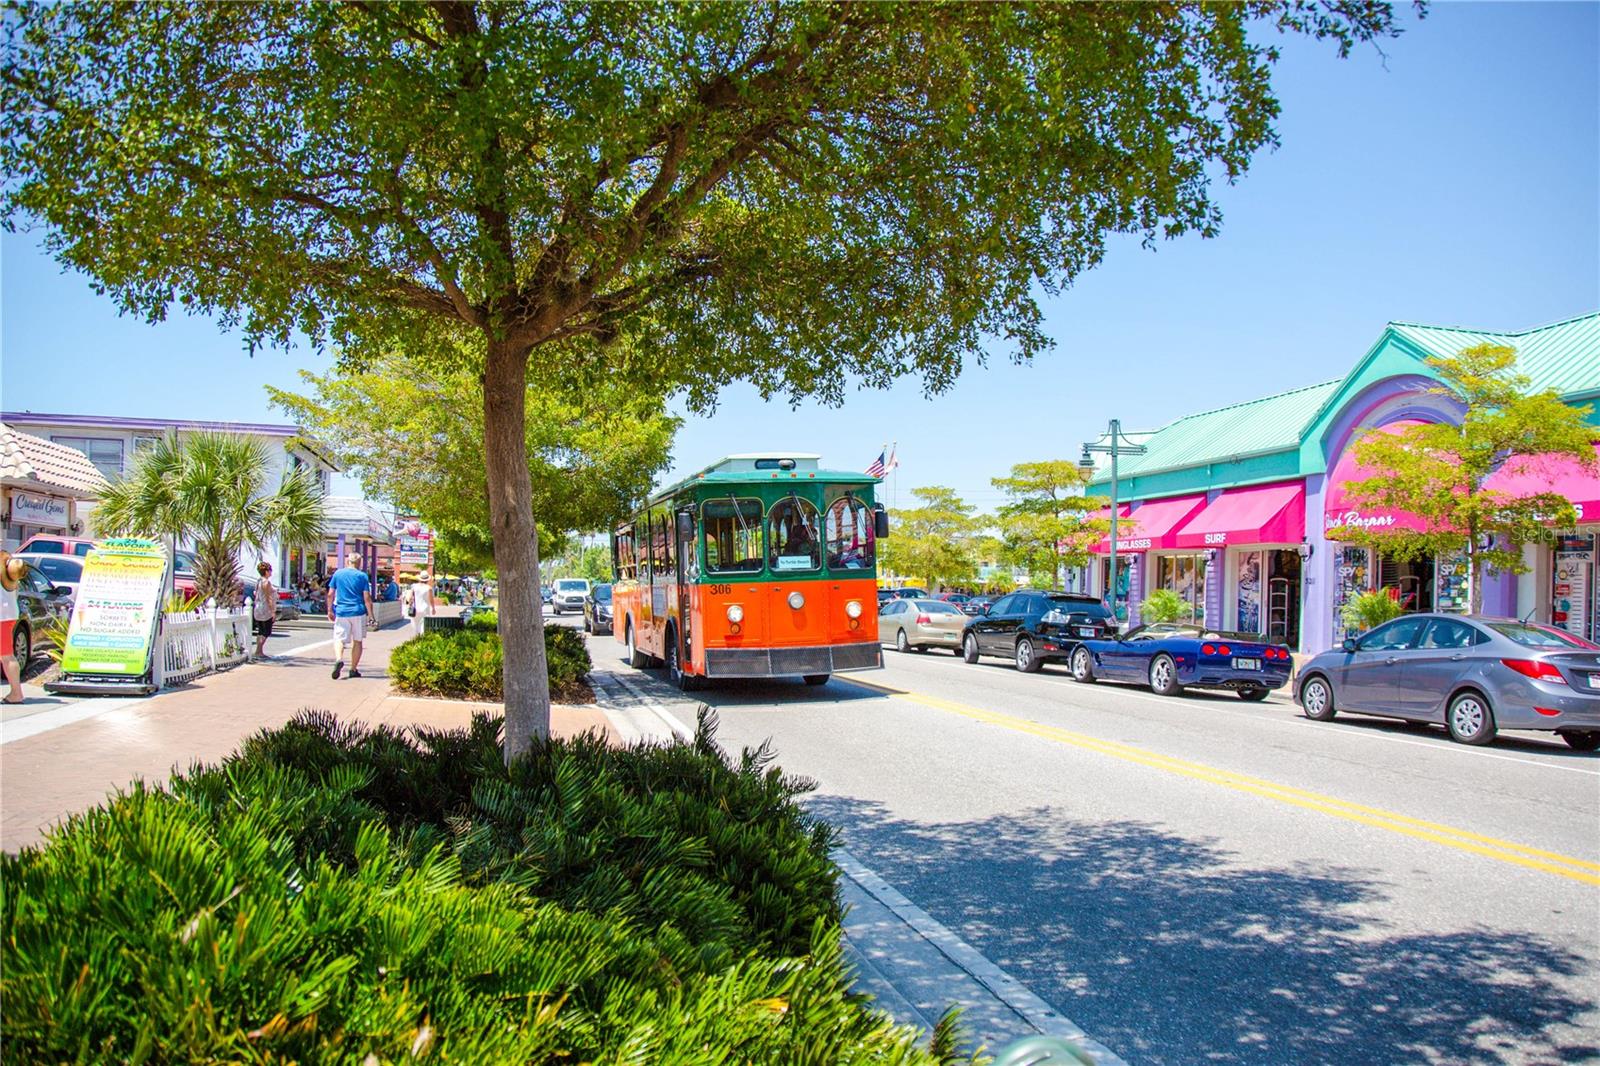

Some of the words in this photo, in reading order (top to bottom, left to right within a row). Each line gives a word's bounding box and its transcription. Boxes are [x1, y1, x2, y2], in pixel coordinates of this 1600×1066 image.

[45, 500, 65, 515] Gems
[1344, 511, 1396, 530] Bazaar
[1204, 533, 1226, 544] SURF
[106, 541, 152, 549] FLAVORS
[1111, 539, 1152, 550] NGLASSES
[710, 584, 732, 595] 306
